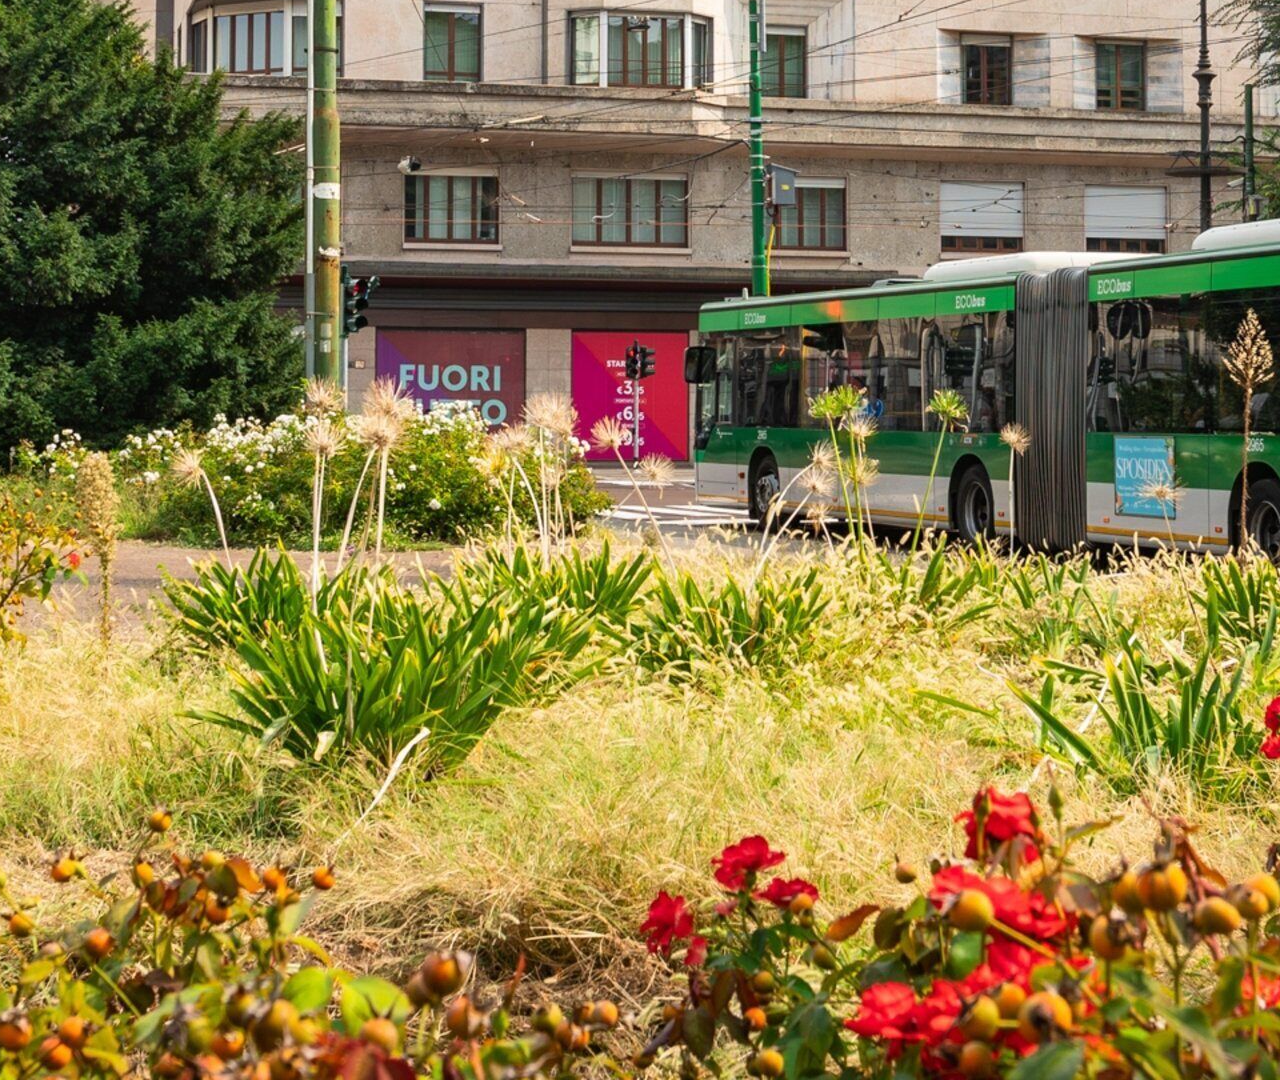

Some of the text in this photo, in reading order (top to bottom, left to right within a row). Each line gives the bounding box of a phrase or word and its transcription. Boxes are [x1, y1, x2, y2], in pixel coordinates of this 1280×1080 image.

[1097, 279, 1131, 295] ECObus
[955, 295, 986, 309] ECObus
[744, 312, 767, 325] ECObus
[400, 364, 501, 392] FUORI
[616, 380, 645, 395] €3,5
[616, 406, 645, 421] €6,5
[1247, 438, 1265, 453] 2965
